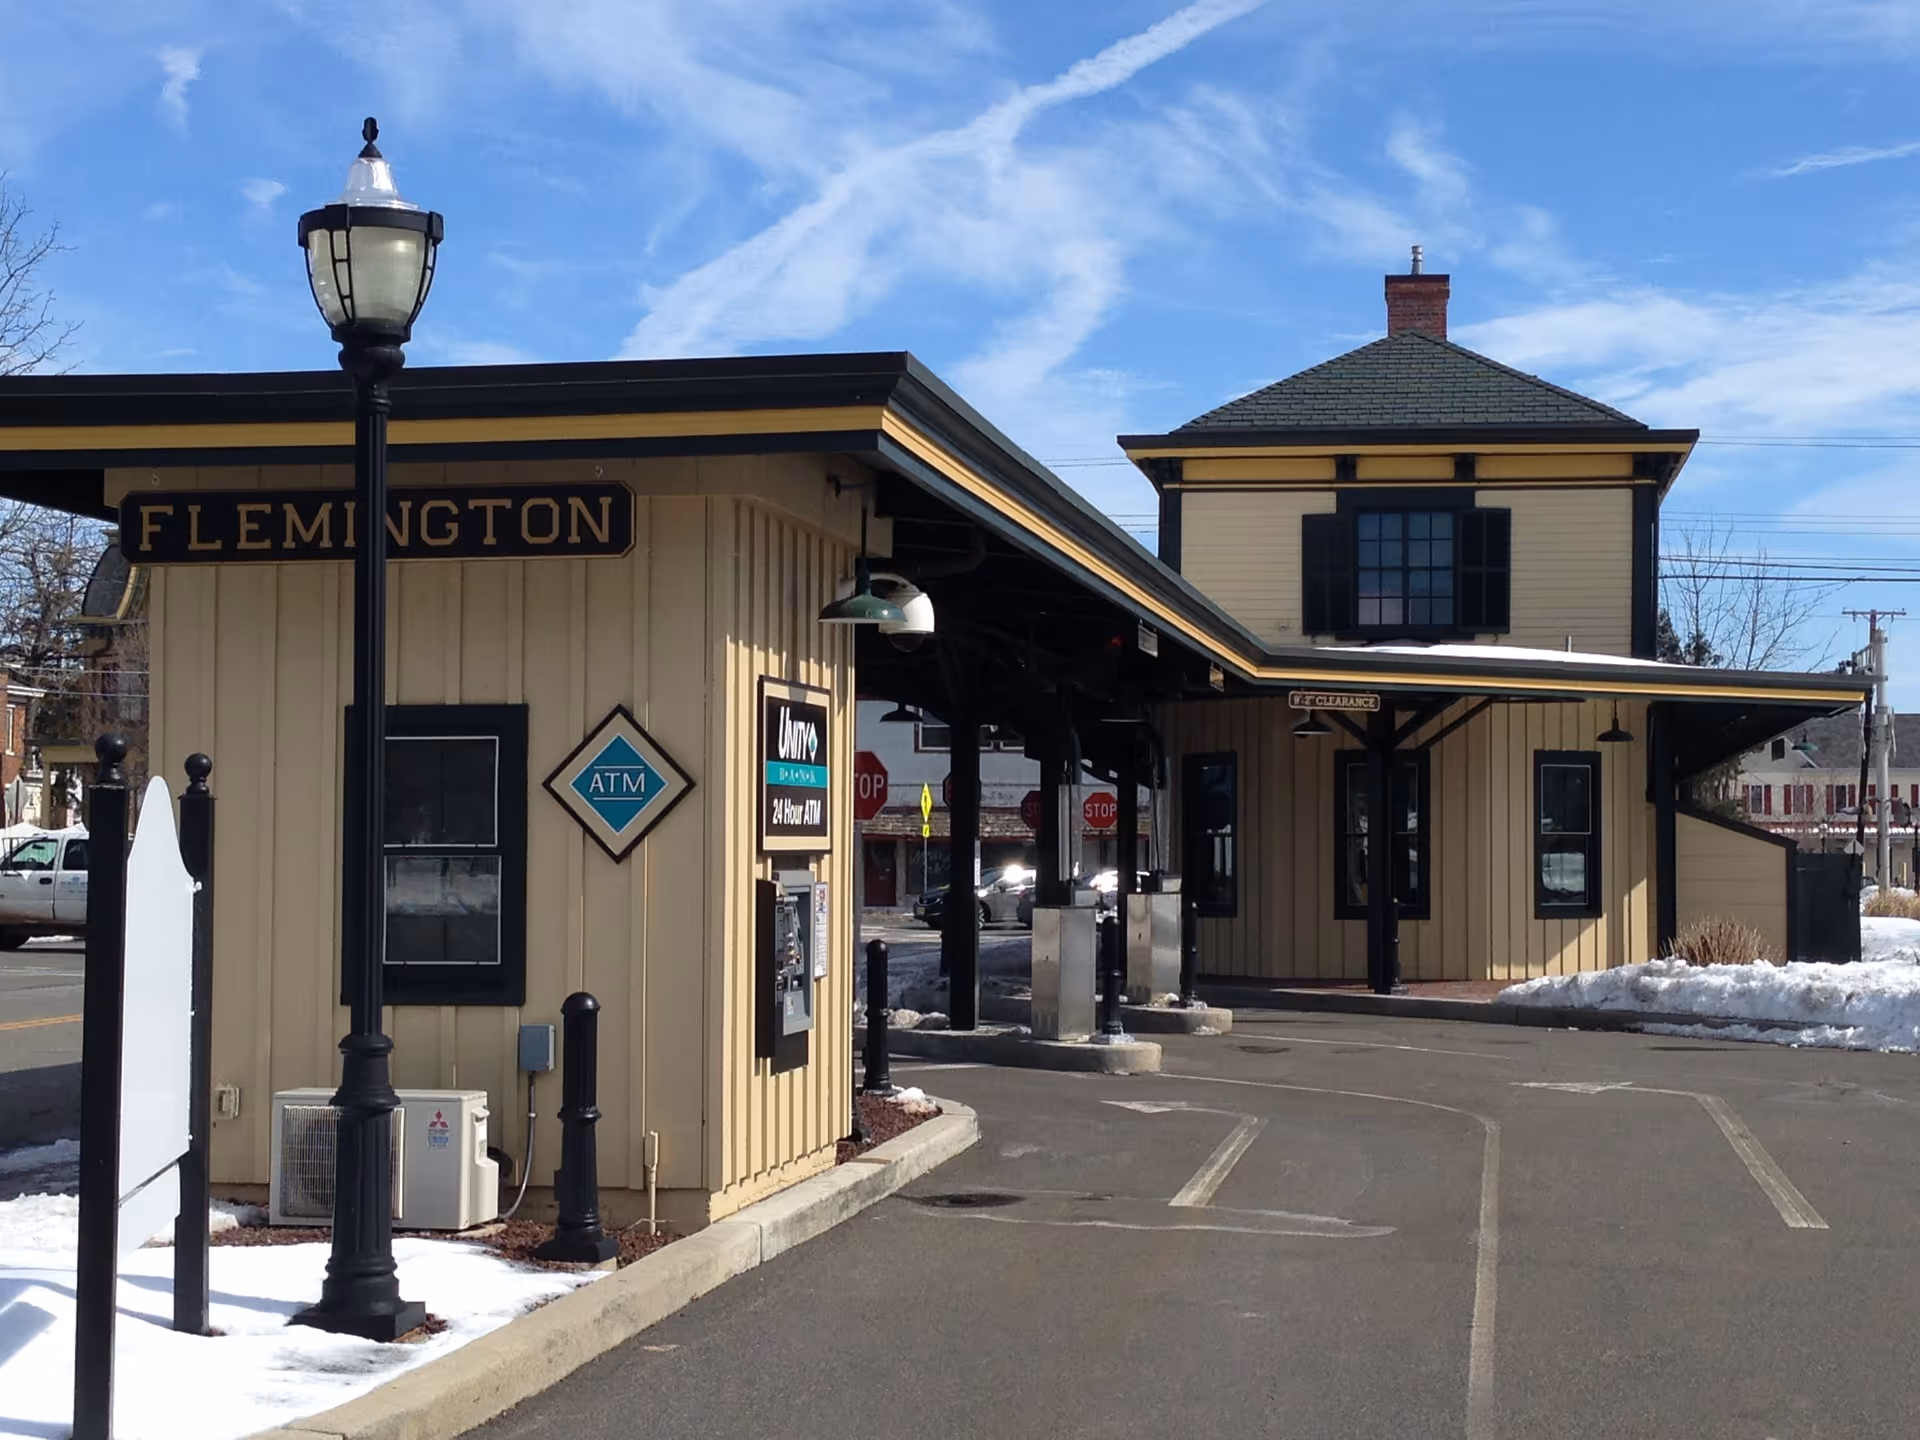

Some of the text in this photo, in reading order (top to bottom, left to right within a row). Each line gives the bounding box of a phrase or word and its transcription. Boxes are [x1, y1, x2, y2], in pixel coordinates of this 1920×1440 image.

[1315, 695, 1376, 707] CLEARANCE
[589, 772, 645, 793] ATM
[772, 798, 821, 826] 24 Hour ATM
[1085, 803, 1117, 817] STOP
